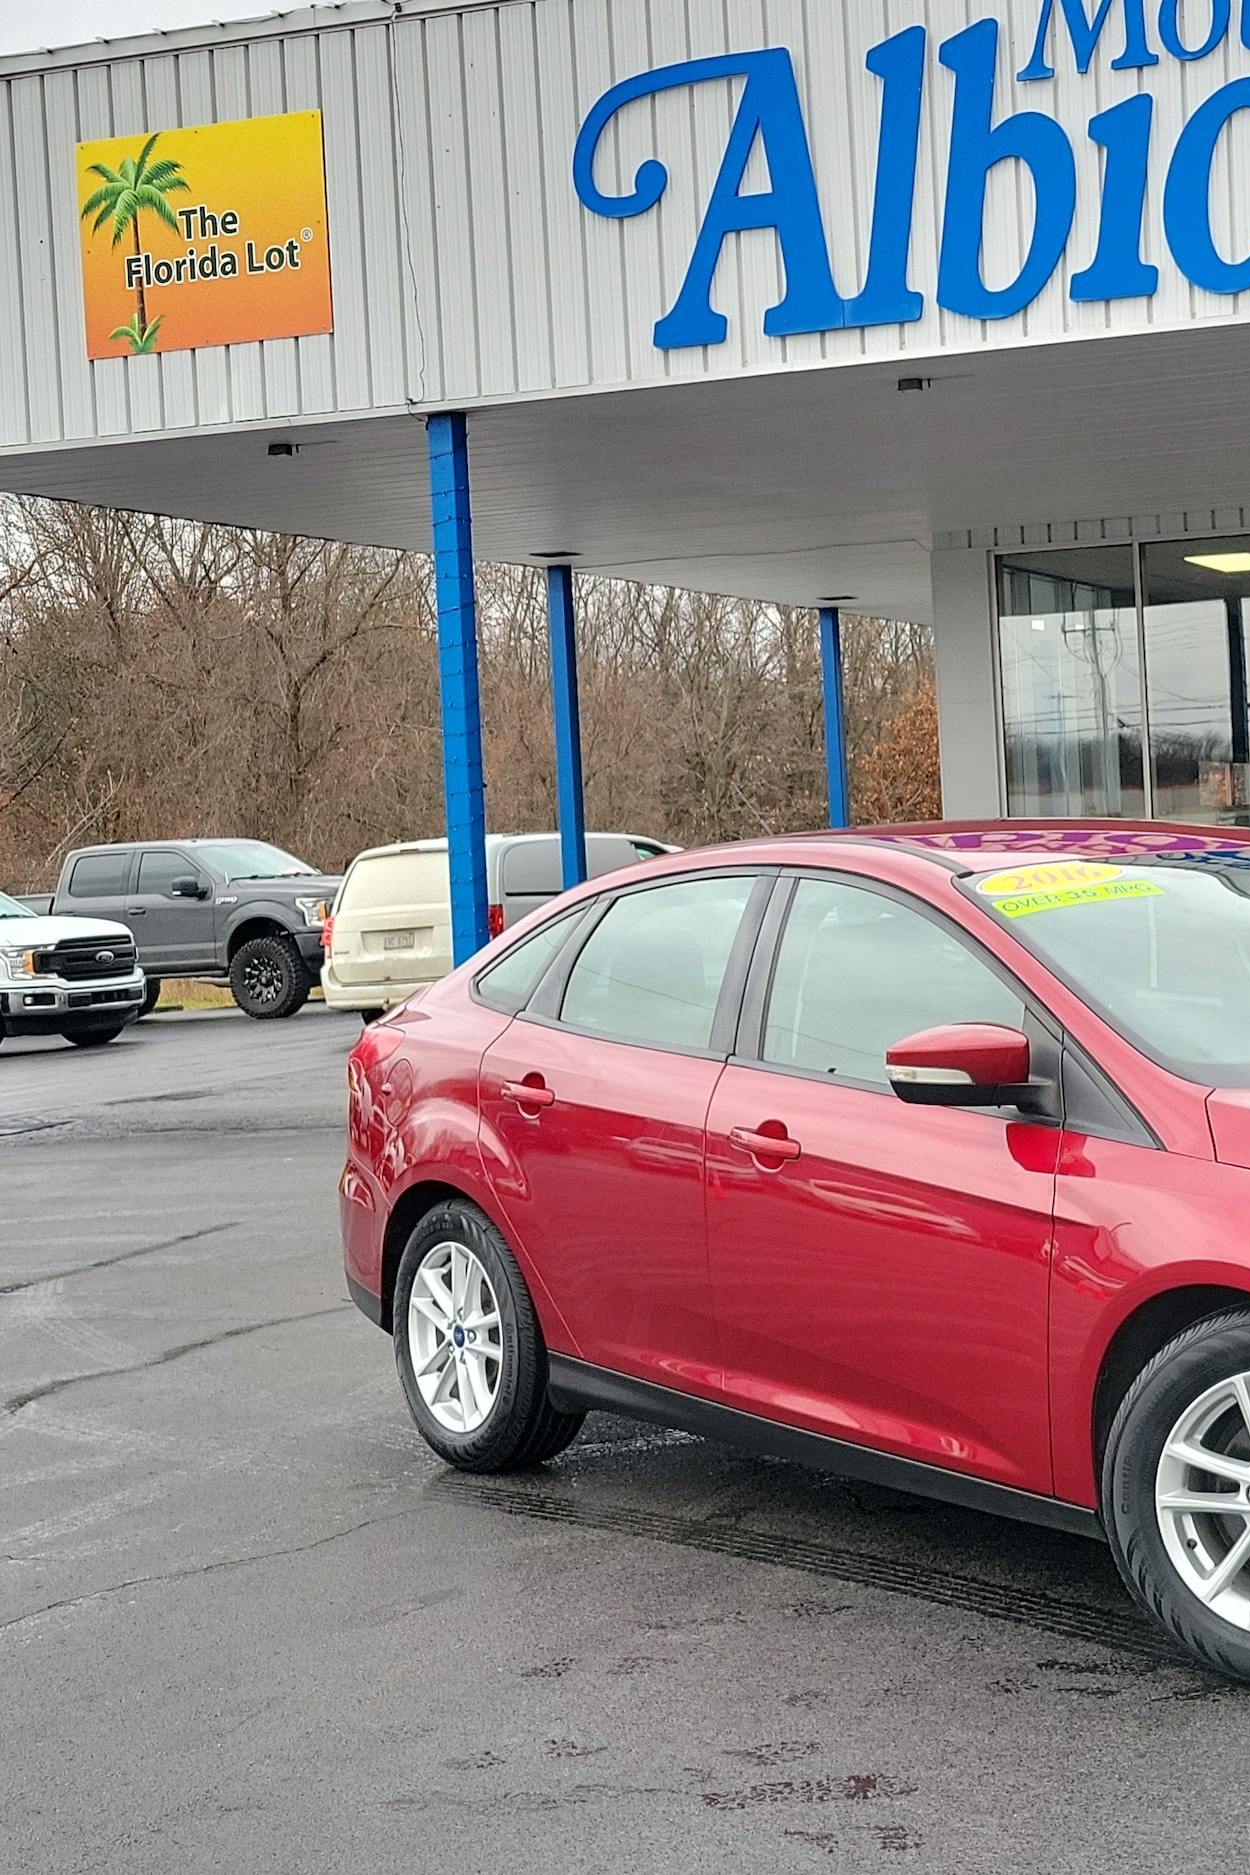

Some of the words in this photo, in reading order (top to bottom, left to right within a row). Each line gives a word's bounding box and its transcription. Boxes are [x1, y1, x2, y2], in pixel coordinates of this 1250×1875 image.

[178, 205, 239, 240] The
[125, 245, 238, 289] Florida
[246, 239, 300, 273] Lot
[1002, 866, 1102, 891] 2016
[1001, 893, 1062, 912] OVER
[1065, 888, 1098, 901] 35
[1103, 882, 1152, 896] MPG
